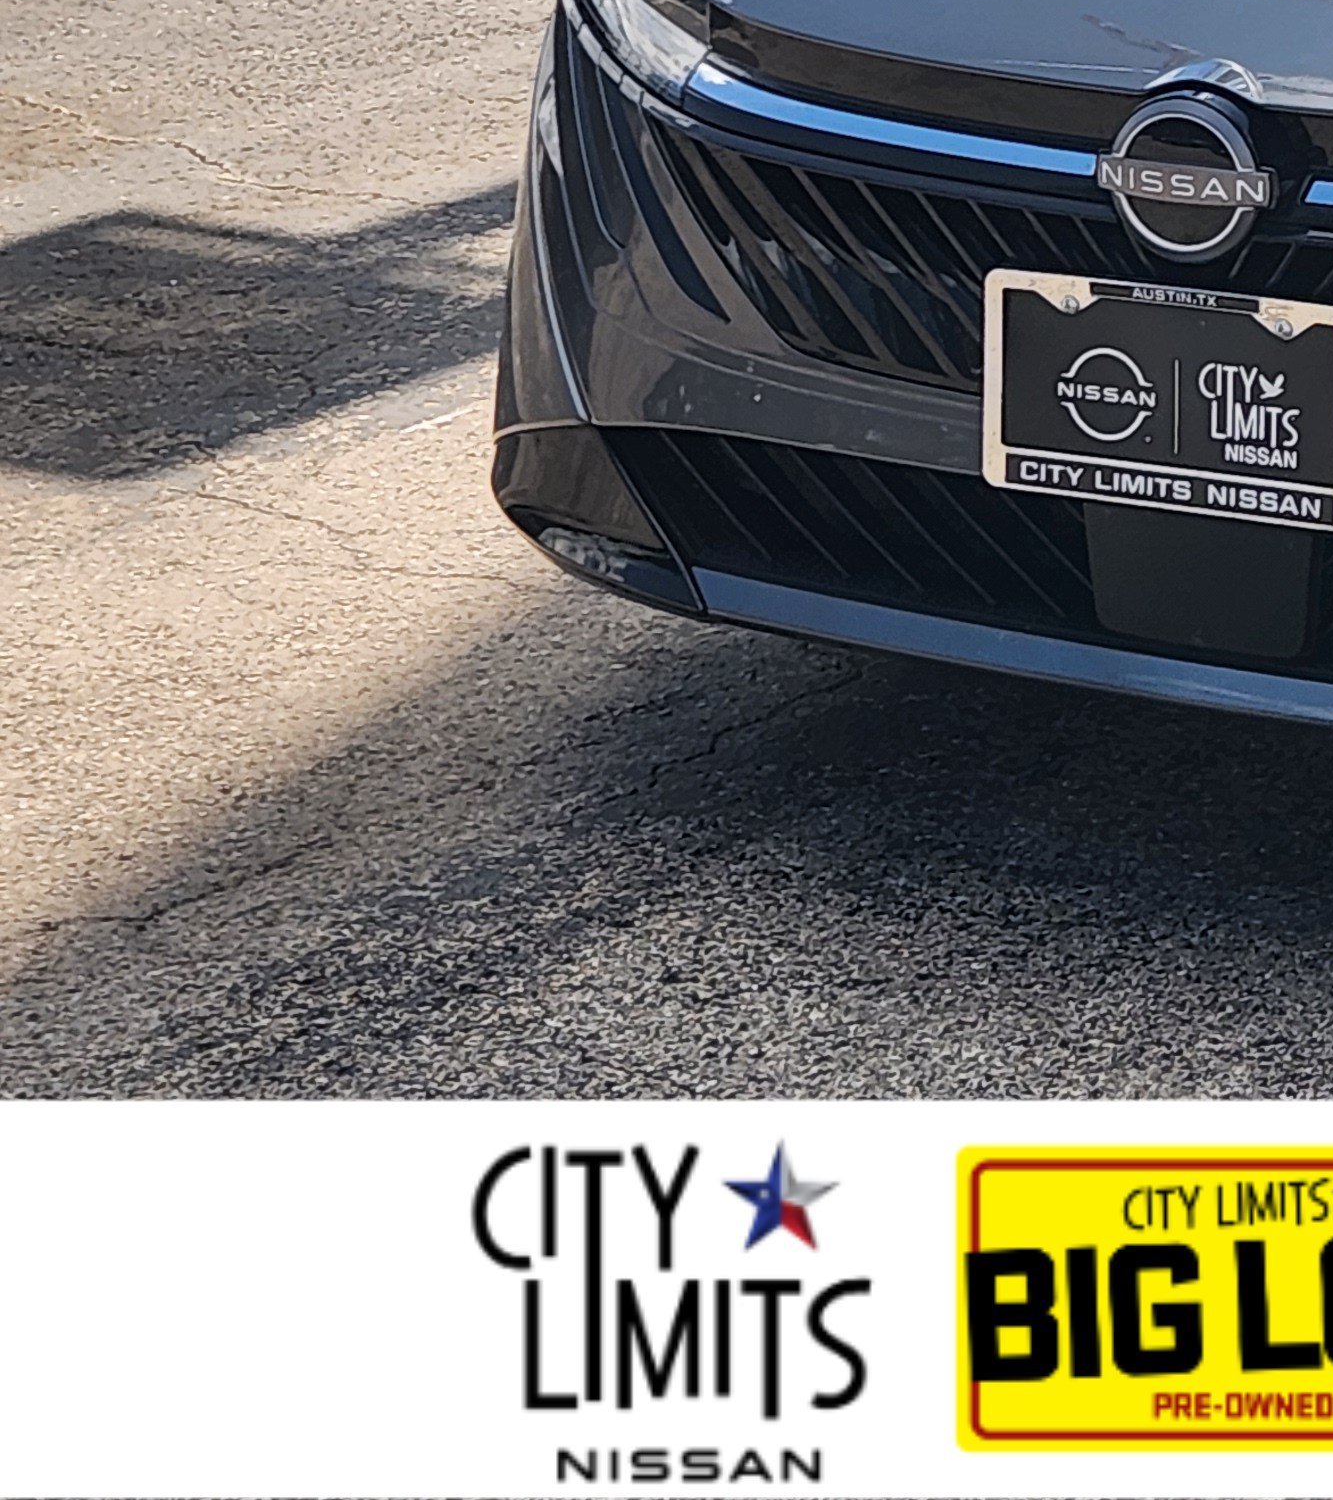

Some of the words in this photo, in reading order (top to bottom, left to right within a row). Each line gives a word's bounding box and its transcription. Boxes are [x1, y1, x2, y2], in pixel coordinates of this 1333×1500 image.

[1101, 161, 1264, 203] NISSAN
[1057, 381, 1156, 408] NISSAN
[1198, 362, 1259, 404] CITY
[1210, 399, 1301, 449] LIMITS
[1224, 443, 1298, 470] NISSAN
[1019, 460, 1086, 487] CITY
[1094, 469, 1193, 501] LIMITS
[1206, 483, 1322, 520] NISSAN
